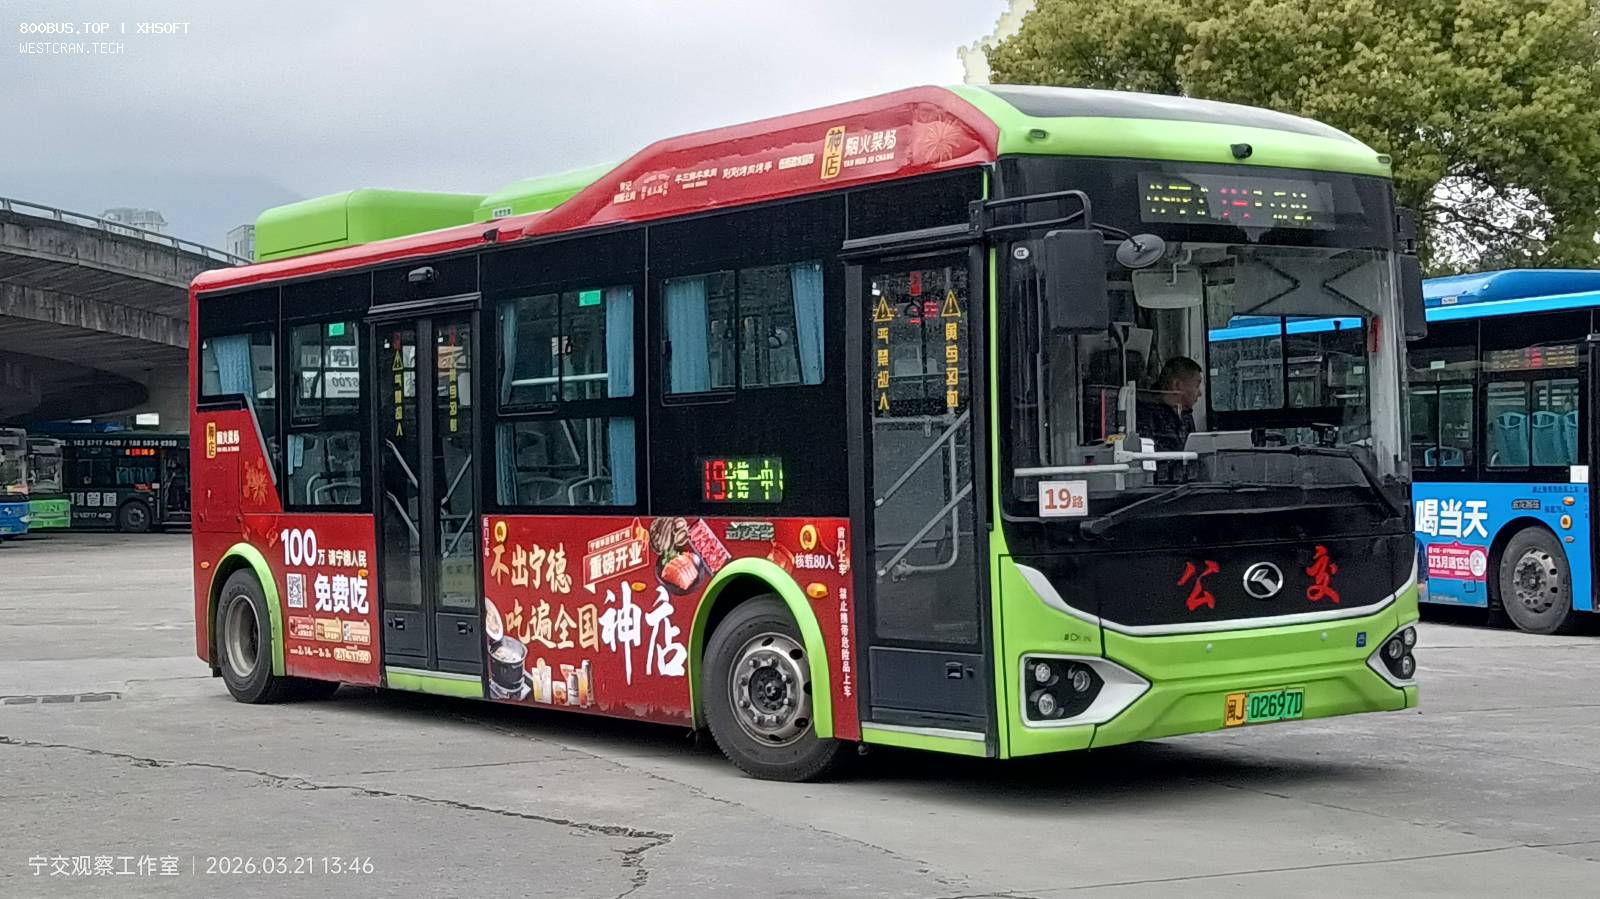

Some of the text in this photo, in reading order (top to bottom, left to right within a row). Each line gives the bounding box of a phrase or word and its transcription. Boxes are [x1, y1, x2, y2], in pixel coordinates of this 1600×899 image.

[824, 128, 843, 177] 神店
[1045, 488, 1084, 509] 19路
[1415, 499, 1488, 538] 喝当天
[491, 542, 572, 594] 不出宁德
[590, 541, 642, 580] 重磅开业
[1177, 544, 1340, 611] 公 交
[314, 573, 370, 614] 免费吃
[505, 599, 600, 653] 吃遍全国
[599, 581, 688, 685] 神店
